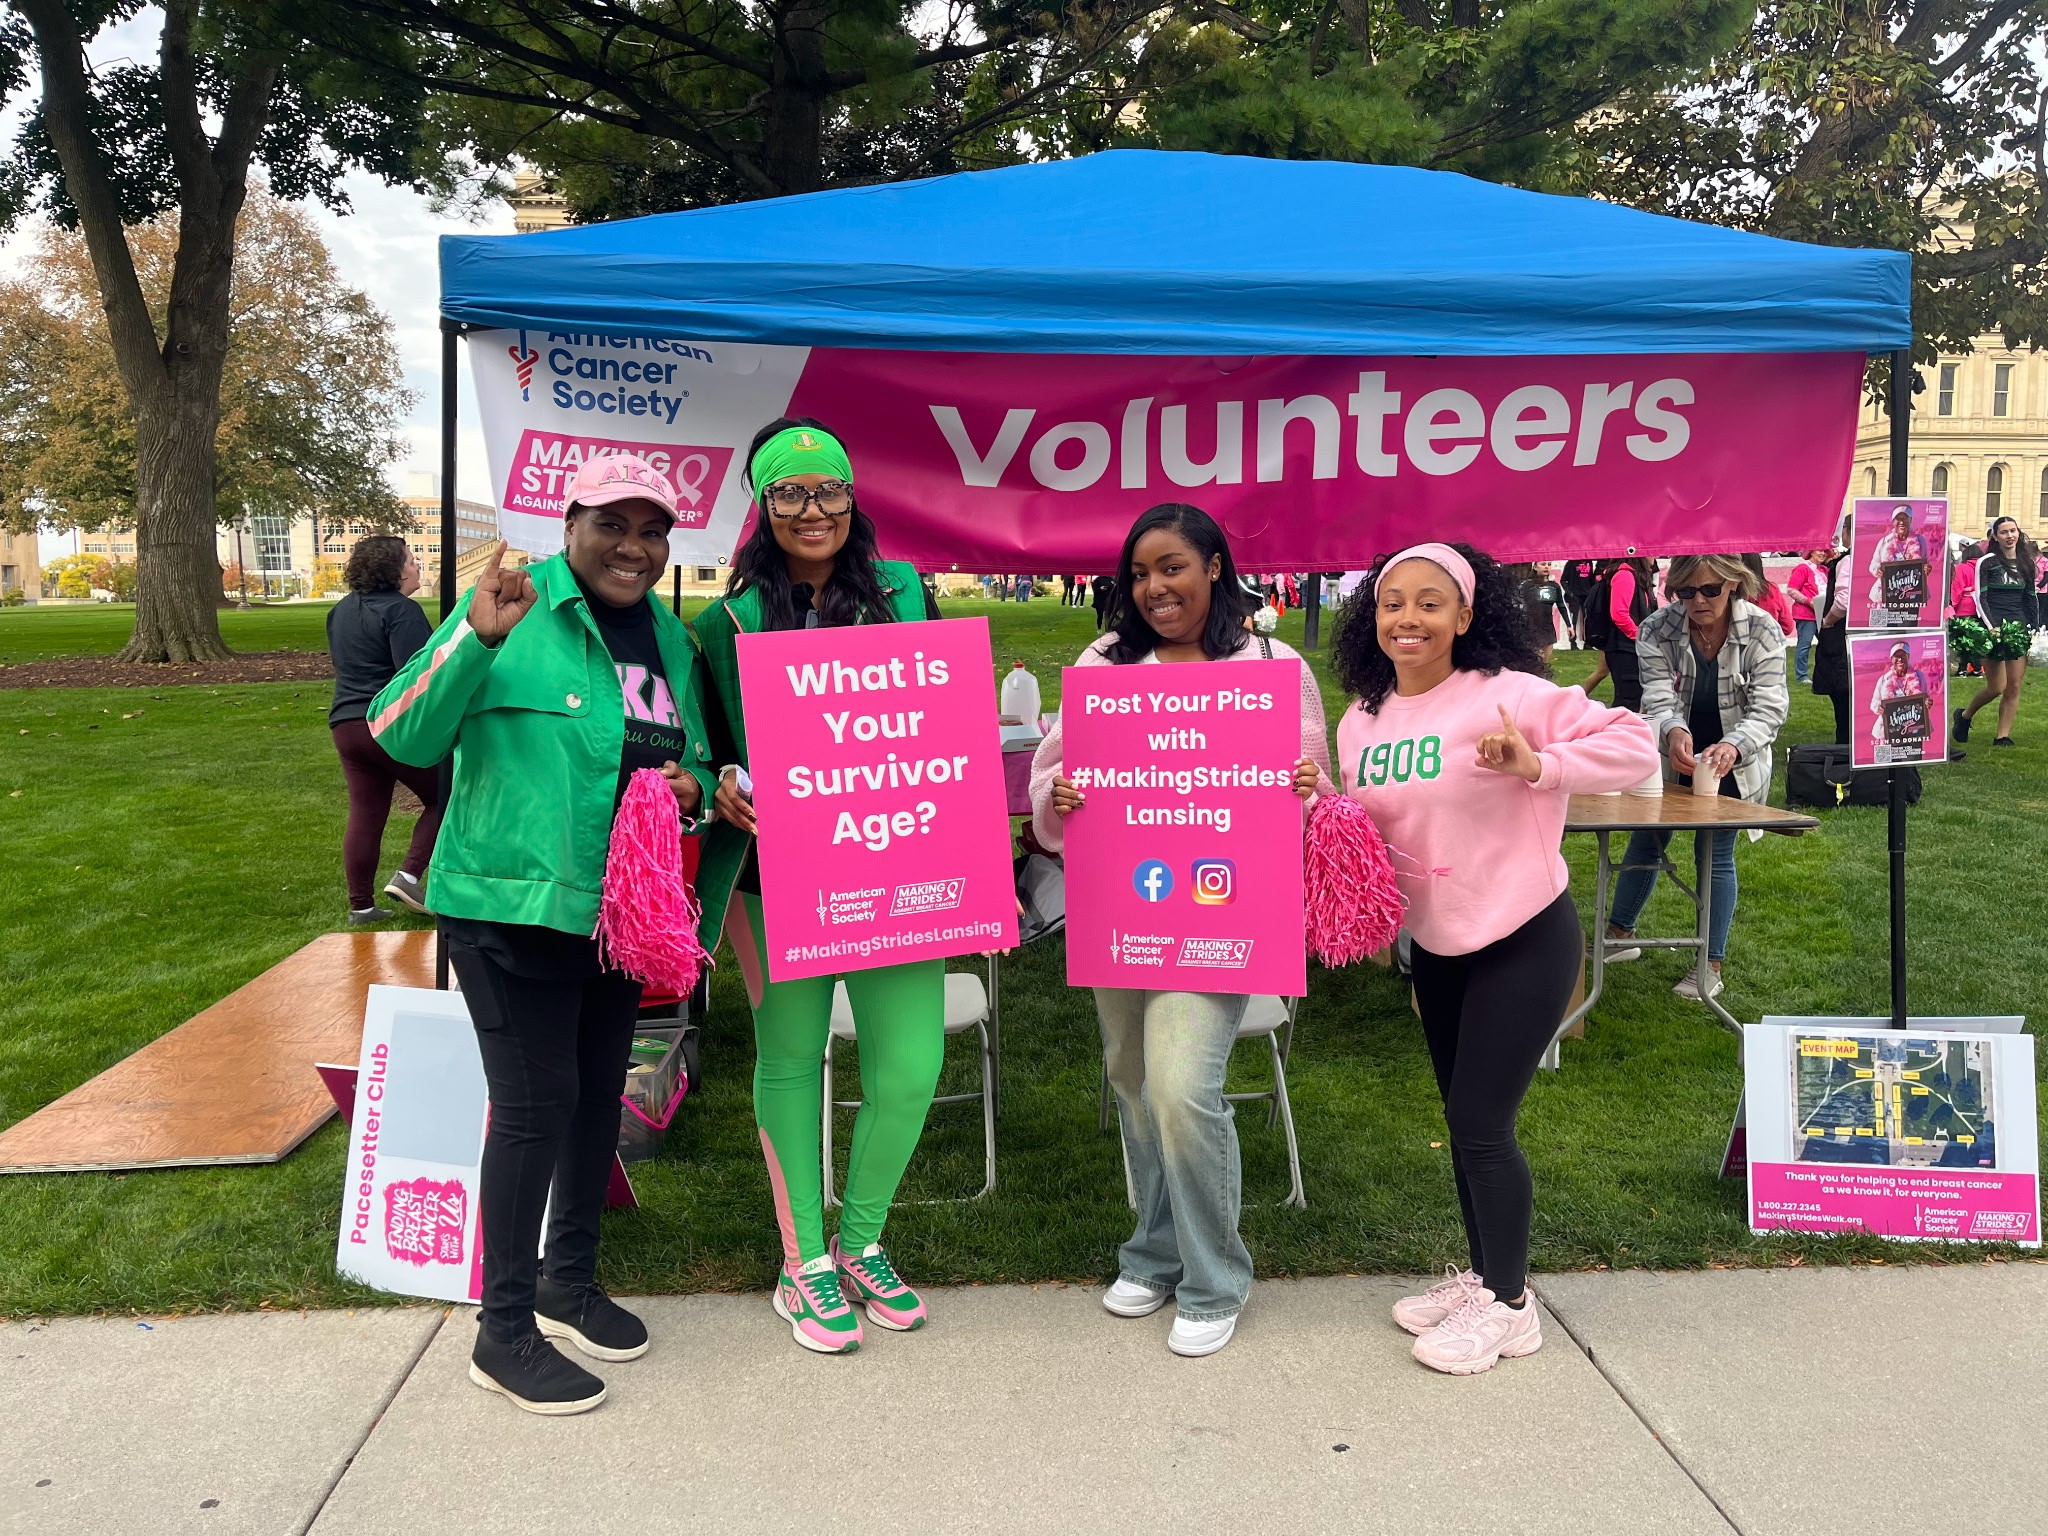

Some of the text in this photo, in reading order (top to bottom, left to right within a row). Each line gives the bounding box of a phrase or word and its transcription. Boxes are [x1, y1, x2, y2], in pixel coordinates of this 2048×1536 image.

[548, 349, 677, 384] Cancer
[928, 371, 1695, 491] Volunteers
[785, 651, 950, 697] What is
[1085, 687, 1273, 715] Post Your Pics
[822, 709, 925, 744] Your
[1147, 726, 1207, 750] with
[1356, 735, 1442, 788] 1908
[787, 752, 969, 798] Survivor
[1071, 764, 1291, 795] #MakingStrides
[831, 801, 937, 851] Age?
[1126, 802, 1231, 832] Lansing
[829, 887, 886, 902] American
[898, 883, 946, 897] MAKING
[829, 900, 873, 913] Cancer
[896, 894, 943, 907] STRIDES
[785, 920, 1003, 963] #MakingStridesLansing
[1122, 933, 1175, 945] American
[1122, 943, 1162, 955] Cancer
[1186, 940, 1233, 951] MAKING
[1184, 949, 1230, 961] STRIDES
[1803, 1044, 1856, 1054] EVENT MAP
[350, 1043, 389, 1244] Pacesetter Club
[1785, 1171, 2002, 1189] Thank you for helping to end breast cancer
[1822, 1186, 1835, 1194] as
[1853, 1186, 1882, 1196] know
[1883, 1187, 1893, 1197] it,
[1894, 1188, 1909, 1197] for
[1911, 1190, 1962, 1200] everyone.
[438, 1193, 464, 1230] Us
[1757, 1201, 1821, 1211] 1.800.227.2345
[1924, 1207, 1968, 1216] American
[388, 1187, 411, 1249] ENDING
[401, 1187, 424, 1253] BREAST
[419, 1191, 442, 1256] CANCER
[1758, 1212, 1863, 1225] MakingStridesWalk.org
[1924, 1216, 1958, 1224] Cancer
[1975, 1220, 2013, 1229] STRIDES
[1977, 1213, 2015, 1221] MAKING
[449, 1236, 460, 1259] WITH
[805, 1262, 818, 1272] AKA
